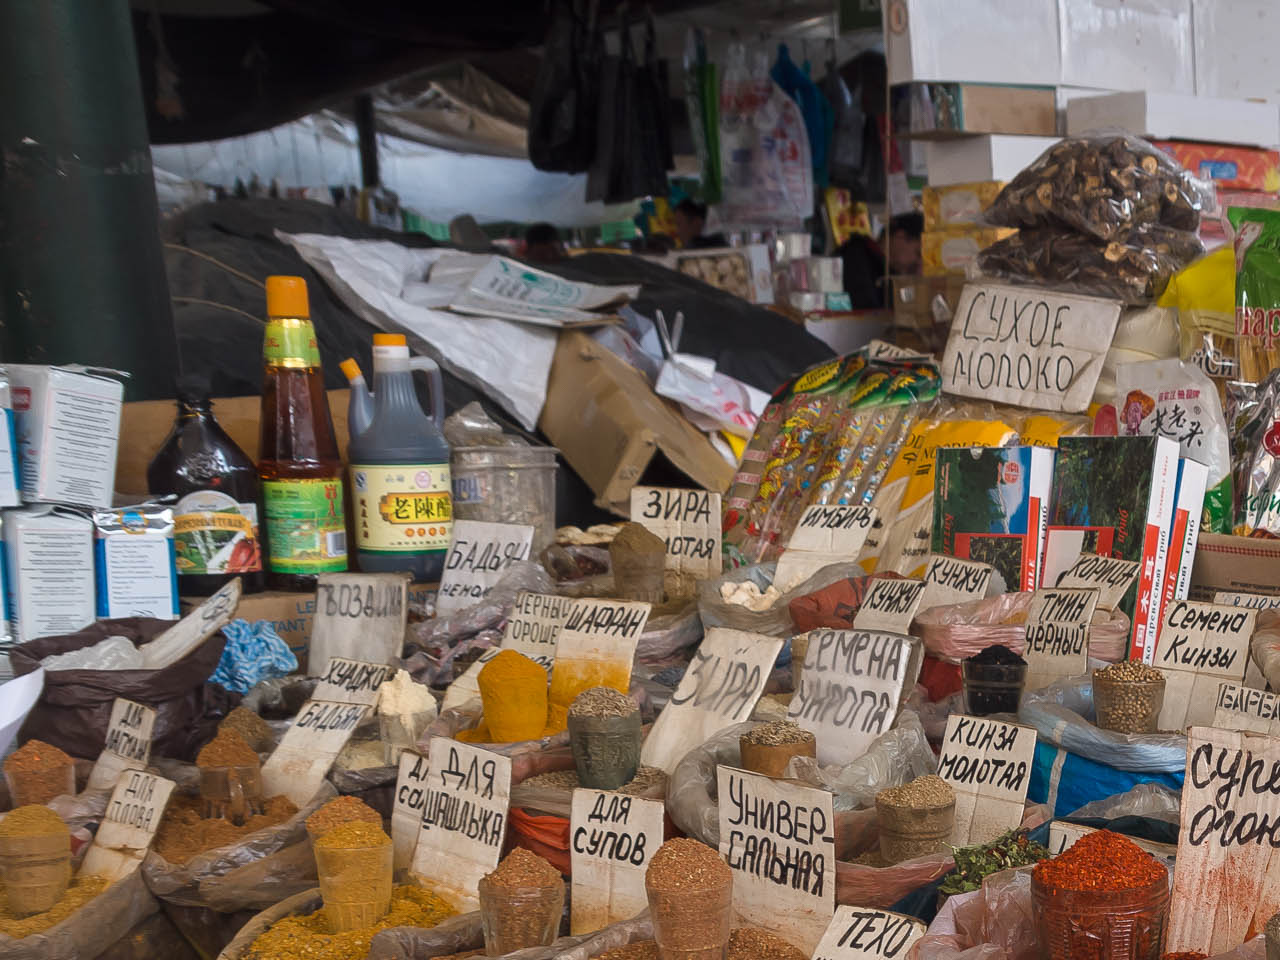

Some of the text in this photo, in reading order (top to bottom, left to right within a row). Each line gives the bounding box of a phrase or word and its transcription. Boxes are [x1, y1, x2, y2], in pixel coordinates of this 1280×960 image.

[963, 291, 1070, 348] СУХОЕ
[952, 350, 1075, 392] МОЛОКО
[642, 489, 711, 525] ЗИРА
[800, 506, 874, 530] ИМБИРЬ
[446, 540, 531, 571] БАДЬЯН
[1066, 555, 1140, 588] КОРИЦА
[927, 557, 992, 593] КУНЖУТ
[563, 602, 646, 637] ШАФРАН
[1039, 591, 1086, 623] ТМИН
[1168, 601, 1249, 635] Семена
[1164, 634, 1238, 670] Кинзы
[296, 703, 361, 732] БАДЬЯН
[951, 716, 1019, 752] КИНЗА
[126, 773, 157, 801] ДЛЯ
[440, 747, 496, 800] ДЛЯ
[938, 753, 1027, 792] МОЛОТАЯ
[111, 800, 156, 833] ПЛОВА
[422, 788, 503, 848] ШАШЛЫКА
[588, 793, 632, 825] ДЛЯ
[728, 775, 834, 846] УНИВЕР-
[573, 826, 648, 867] СУПОВ
[728, 830, 826, 898] САЛЬНАЯ
[836, 911, 915, 959] ТЕХО
